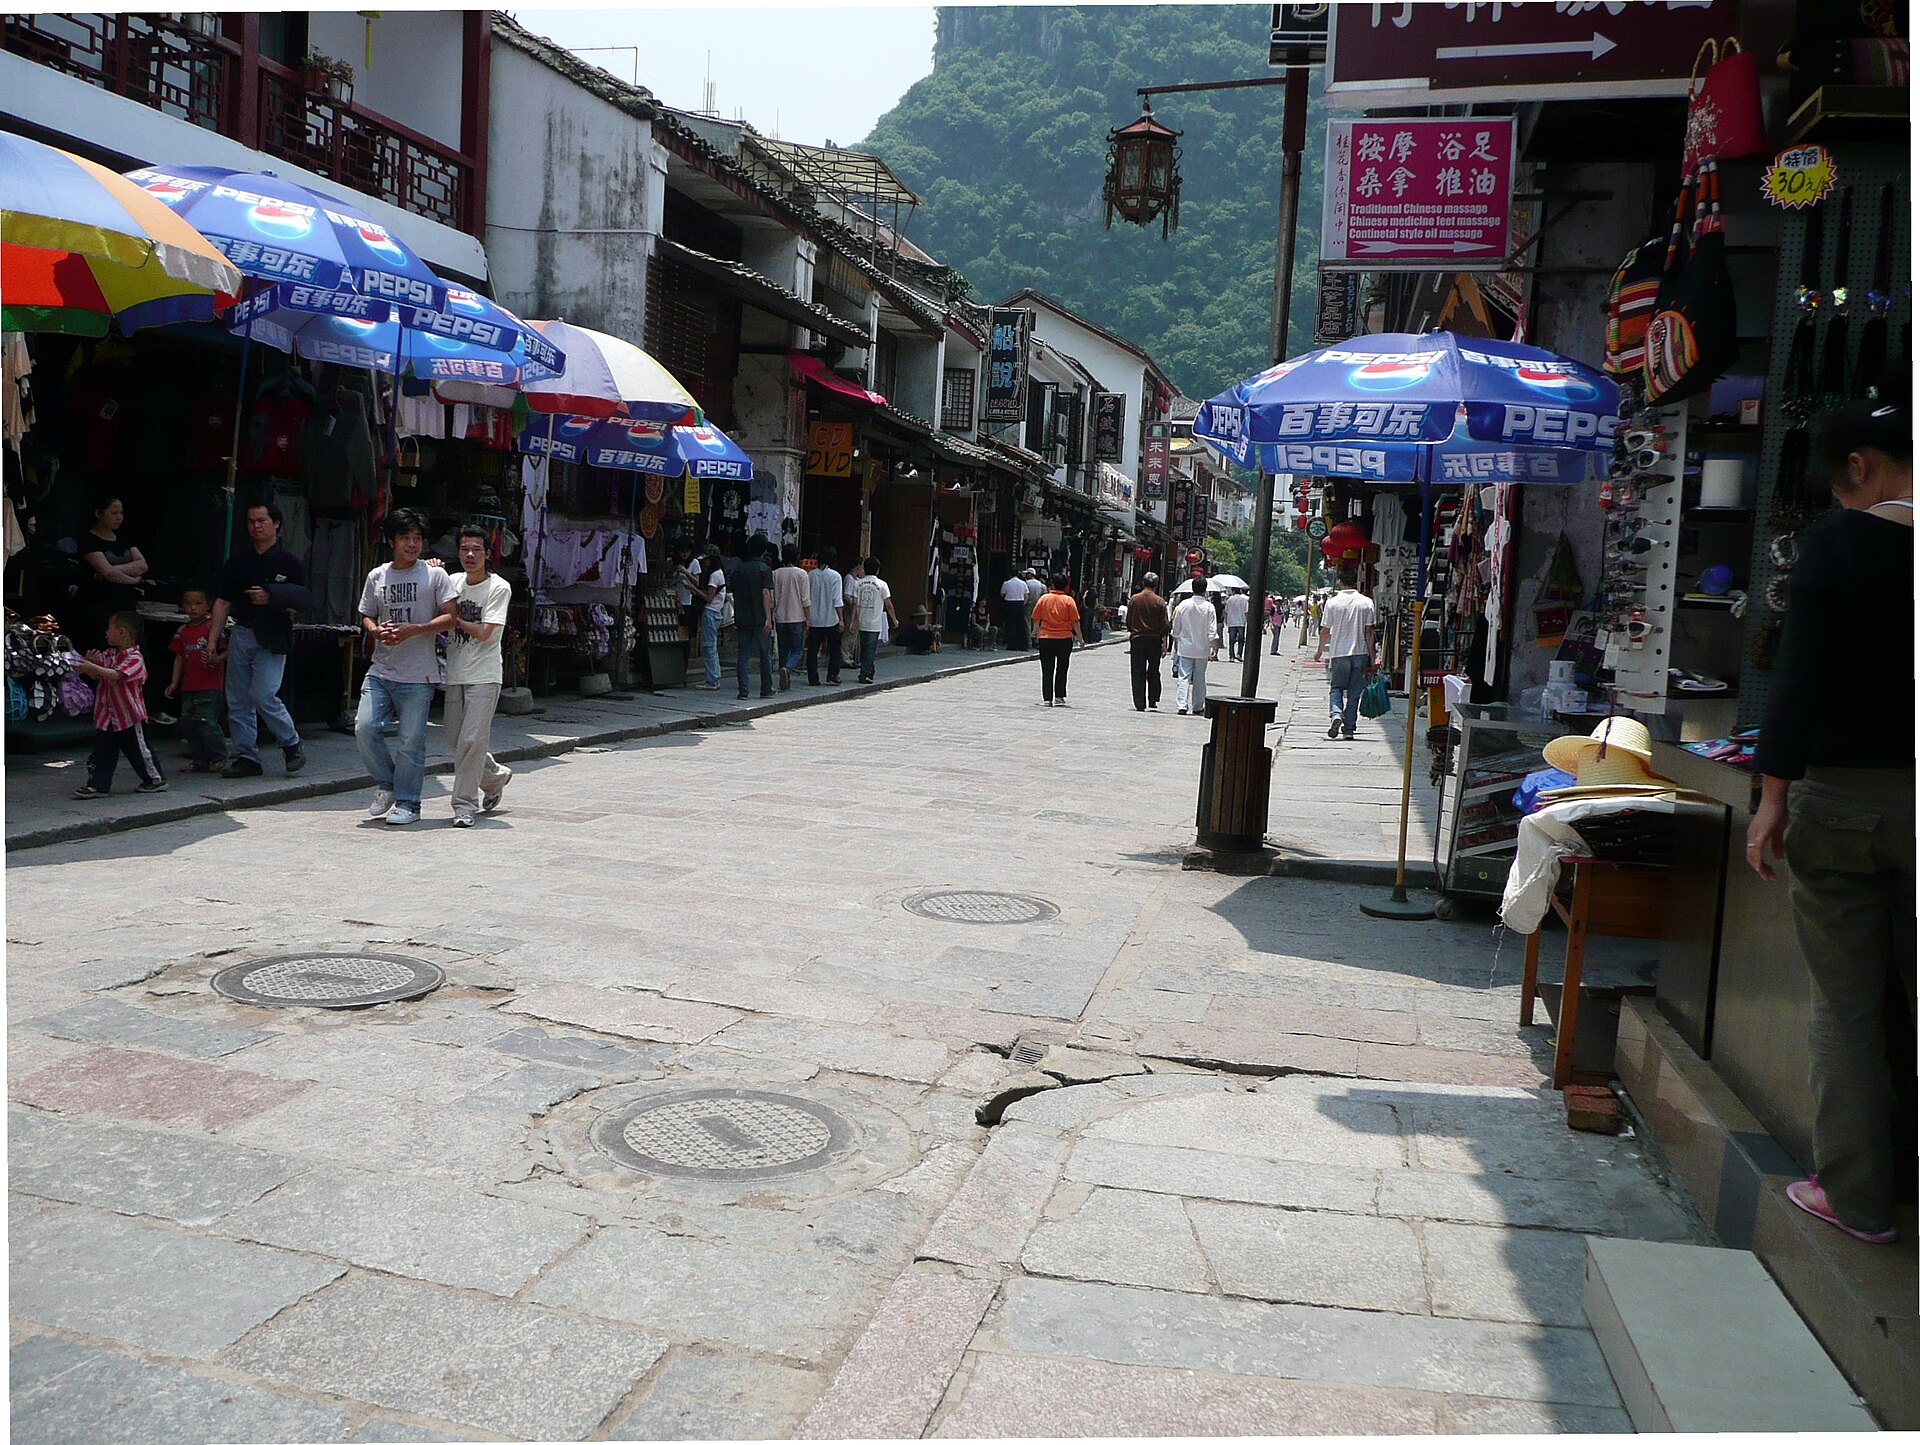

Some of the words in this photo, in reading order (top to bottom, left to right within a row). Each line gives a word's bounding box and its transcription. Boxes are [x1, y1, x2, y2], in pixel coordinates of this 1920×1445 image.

[1437, 131, 1498, 162] 浴足
[1435, 167, 1496, 197] 推油
[212, 185, 318, 218] PEPSI
[1350, 203, 1401, 214] Traditional
[1404, 203, 1442, 214] Chinese
[1444, 204, 1488, 215] massage
[1350, 215, 1388, 226] Chinese
[1390, 215, 1434, 226] medicine
[1457, 216, 1501, 227] massage
[1349, 228, 1398, 239] Continetal
[1400, 228, 1423, 239] style
[1425, 228, 1438, 239] oil
[1439, 228, 1483, 239] massage
[364, 269, 432, 305] PEPSI
[290, 285, 371, 316] 百事可乐
[412, 308, 502, 346] PEPSI
[1315, 350, 1448, 365] PEPSI
[607, 416, 668, 430] PEPSI
[1278, 402, 1428, 436] 百事可乐
[529, 436, 576, 460] PEPSI
[815, 427, 845, 447] CD
[597, 448, 668, 471] 百事可乐
[696, 460, 742, 477] PEPSI
[806, 450, 850, 473] DVD
[1310, 522, 1325, 535] 茶
